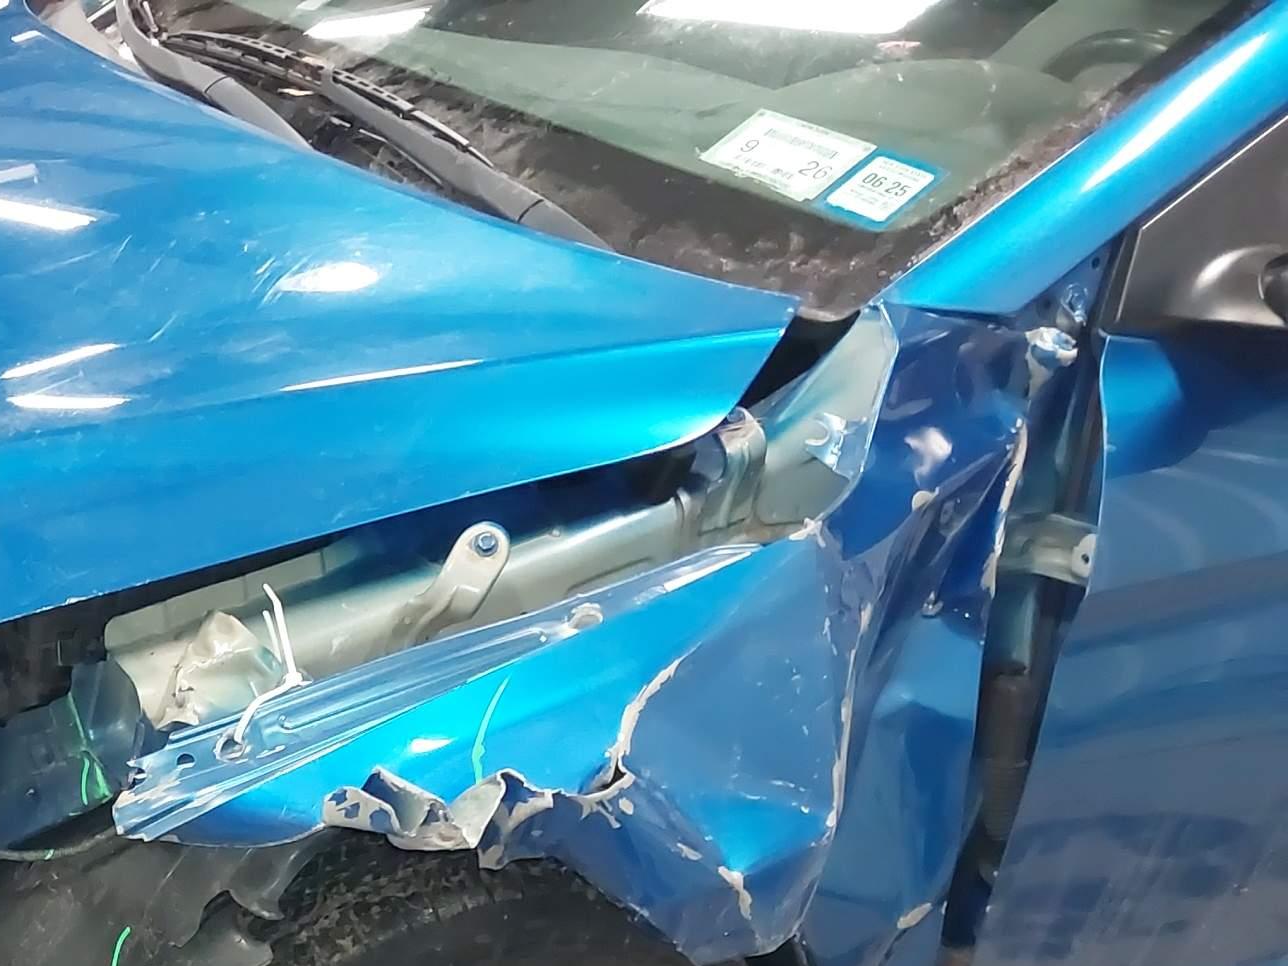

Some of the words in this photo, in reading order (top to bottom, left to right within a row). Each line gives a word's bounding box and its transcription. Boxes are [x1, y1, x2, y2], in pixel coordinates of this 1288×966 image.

[739, 138, 760, 153] 9
[798, 160, 833, 180] 26
[862, 172, 885, 189] 06
[884, 180, 912, 198] 25
